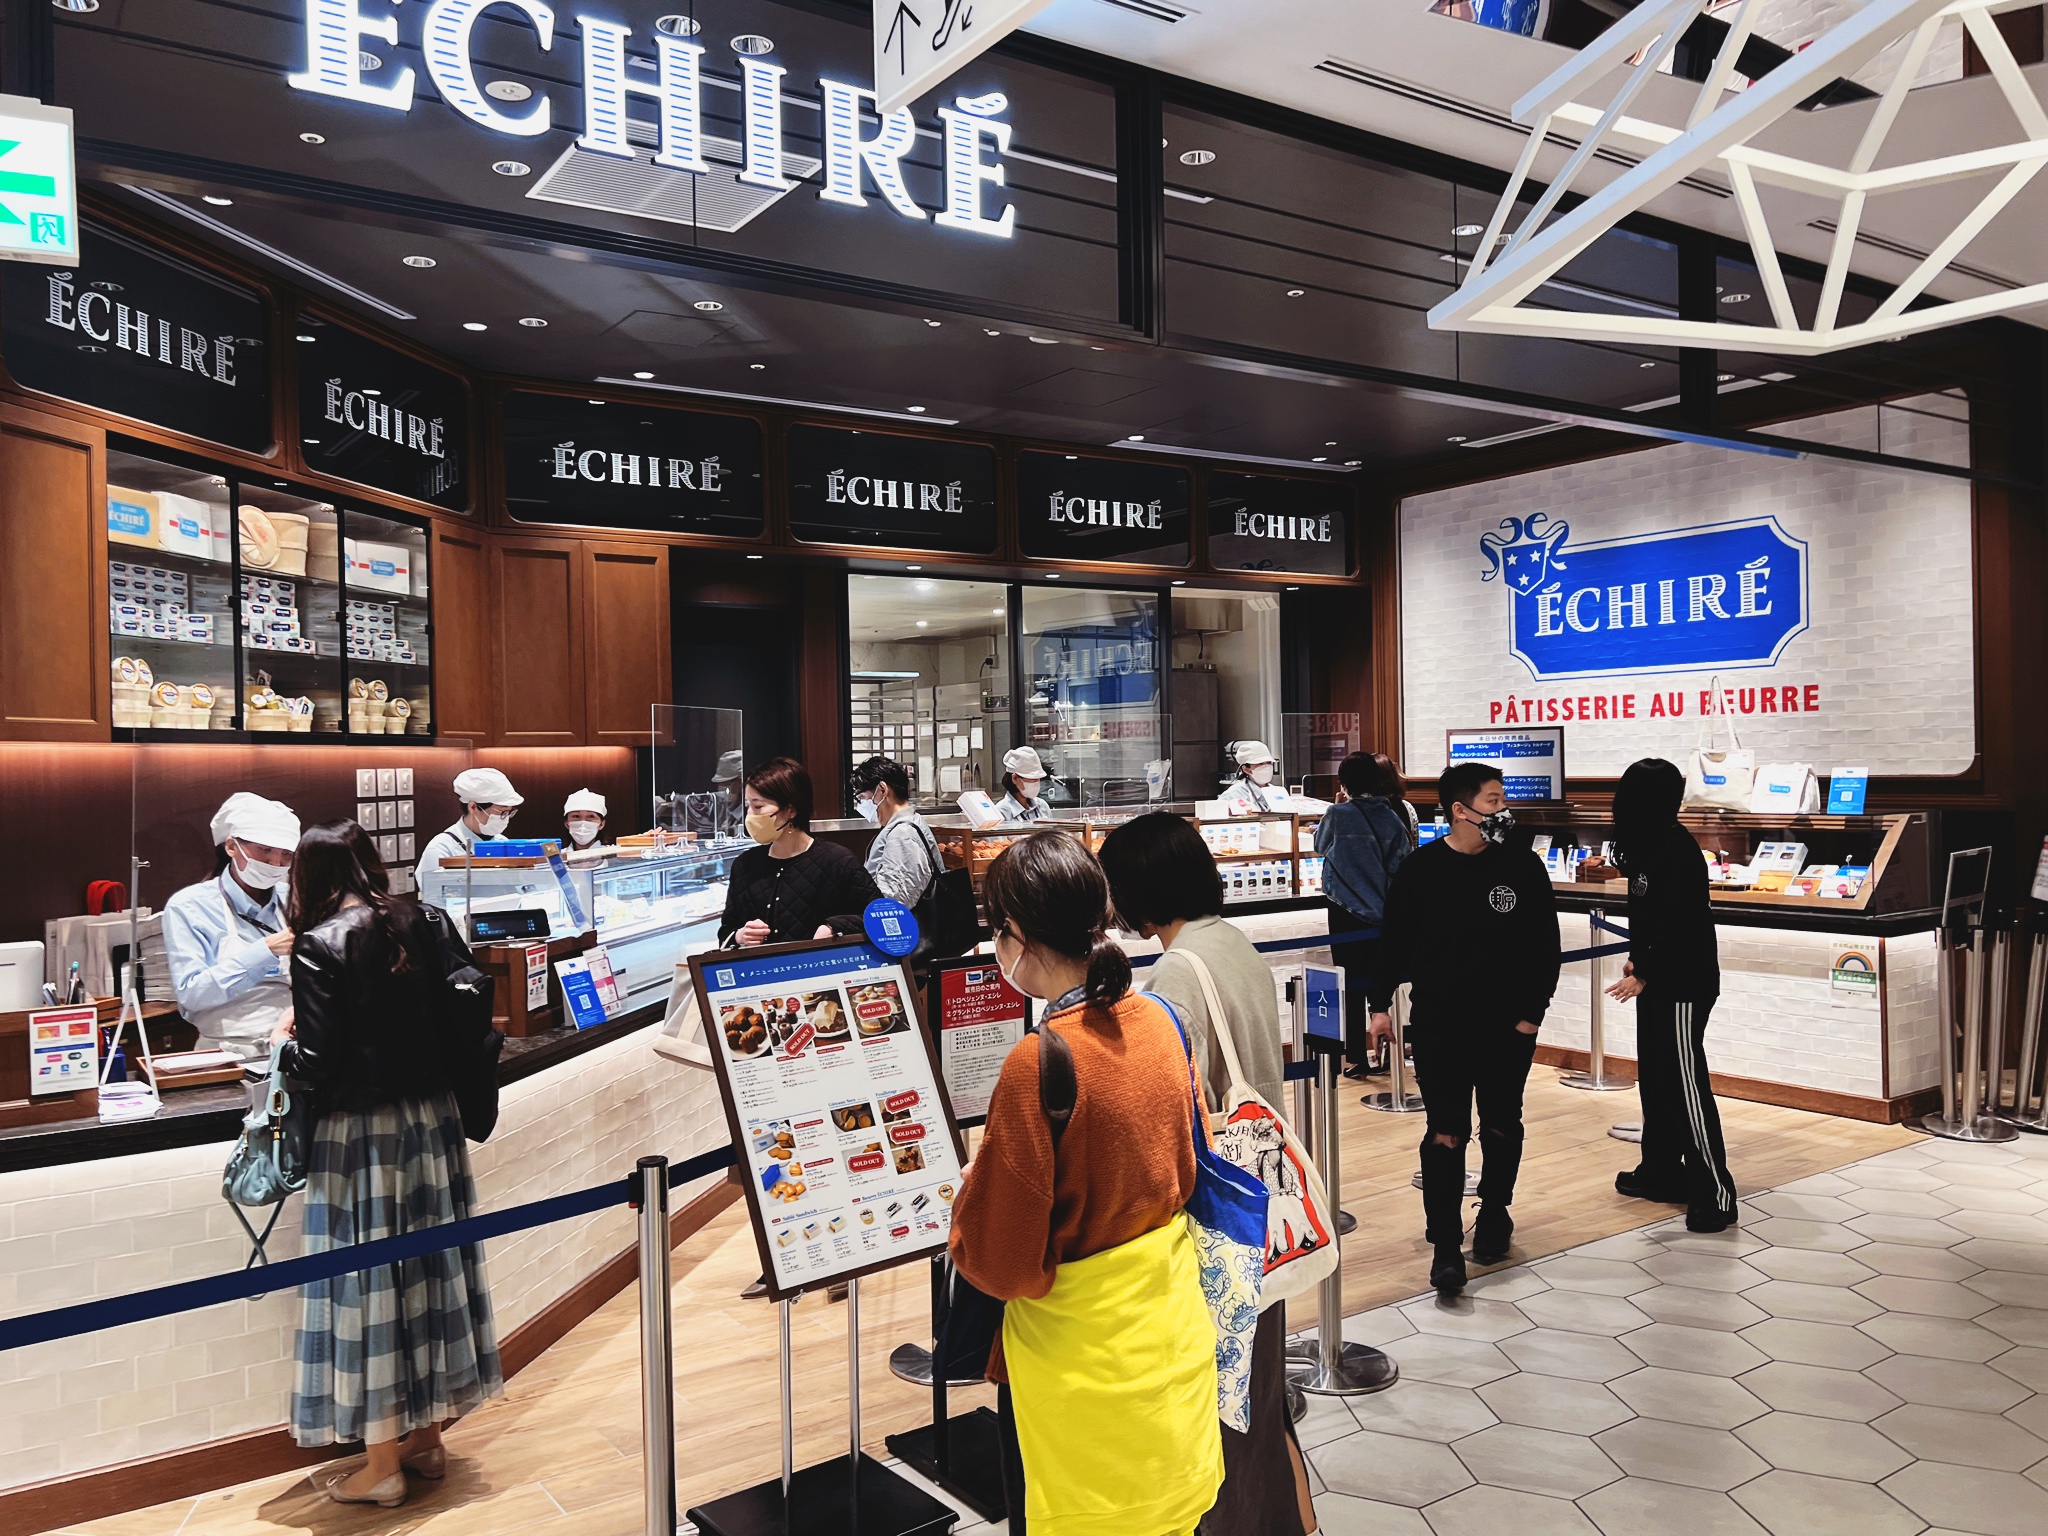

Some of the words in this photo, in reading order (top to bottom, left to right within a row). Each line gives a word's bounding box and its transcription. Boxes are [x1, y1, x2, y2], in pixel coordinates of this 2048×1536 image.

[45, 271, 237, 387] ÉCHIRÉ
[324, 377, 445, 459] ÉCHIRÉ
[552, 441, 722, 492] ÉCHIRÉ
[826, 468, 963, 513] ÉCHIRÉ
[1049, 491, 1163, 530] ÉCHIRÉ
[1234, 507, 1332, 543] ÉCHIRÉ
[1534, 555, 1773, 638] ÉCHIRÉ
[1490, 692, 1636, 724] PÂTISSERIE
[1650, 691, 1684, 718] AU
[965, 983, 1001, 994] 販売日のご案内
[1317, 990, 1328, 1018] 入口
[861, 1007, 877, 1015] SOLD
[789, 1038, 802, 1051] SOLD
[890, 1098, 904, 1107] SOLD
[903, 1095, 915, 1103] OUT
[895, 1130, 910, 1138] SOLD
[909, 1128, 921, 1136] OUT
[852, 1160, 868, 1168] SOLD
